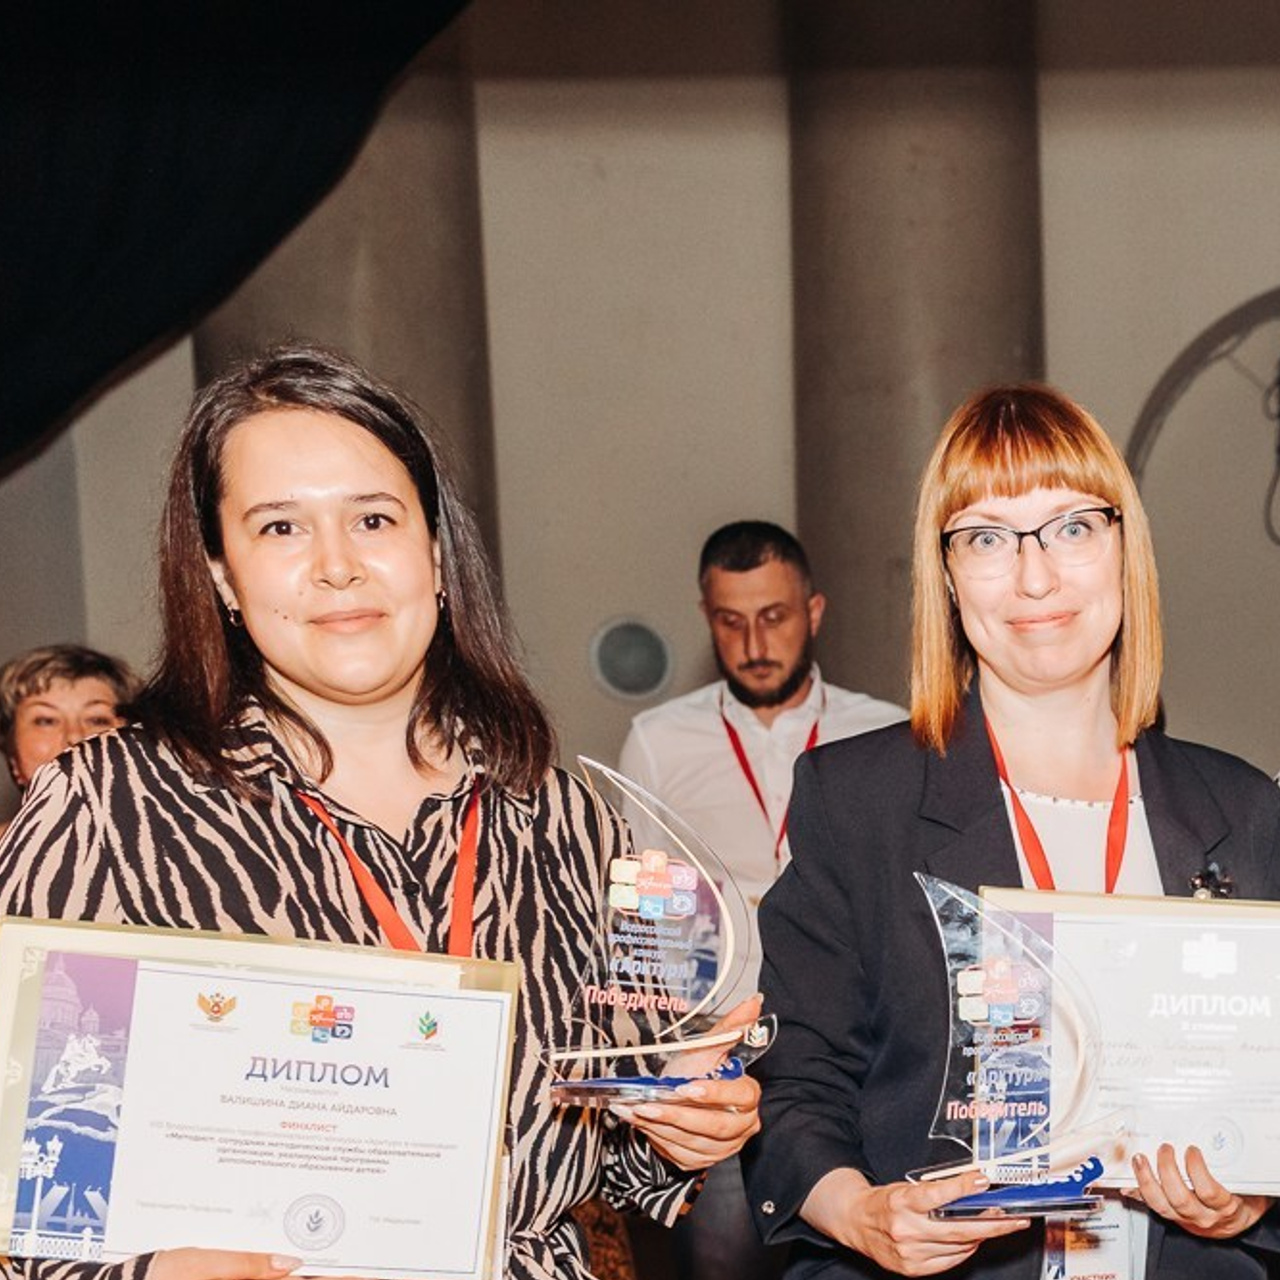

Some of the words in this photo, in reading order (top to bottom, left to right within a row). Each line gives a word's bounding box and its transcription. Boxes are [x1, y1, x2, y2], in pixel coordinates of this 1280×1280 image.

[585, 985, 689, 1012] Победитель
[1148, 993, 1272, 1017] ДИПЛОМ
[245, 1056, 390, 1088] ДИПЛОМ
[287, 1099, 328, 1112] ДИАНА
[330, 1103, 398, 1117] АЙДАРОВНА
[946, 1101, 1048, 1120] Победитель
[280, 1120, 339, 1134] ФИНАЛИСТ
